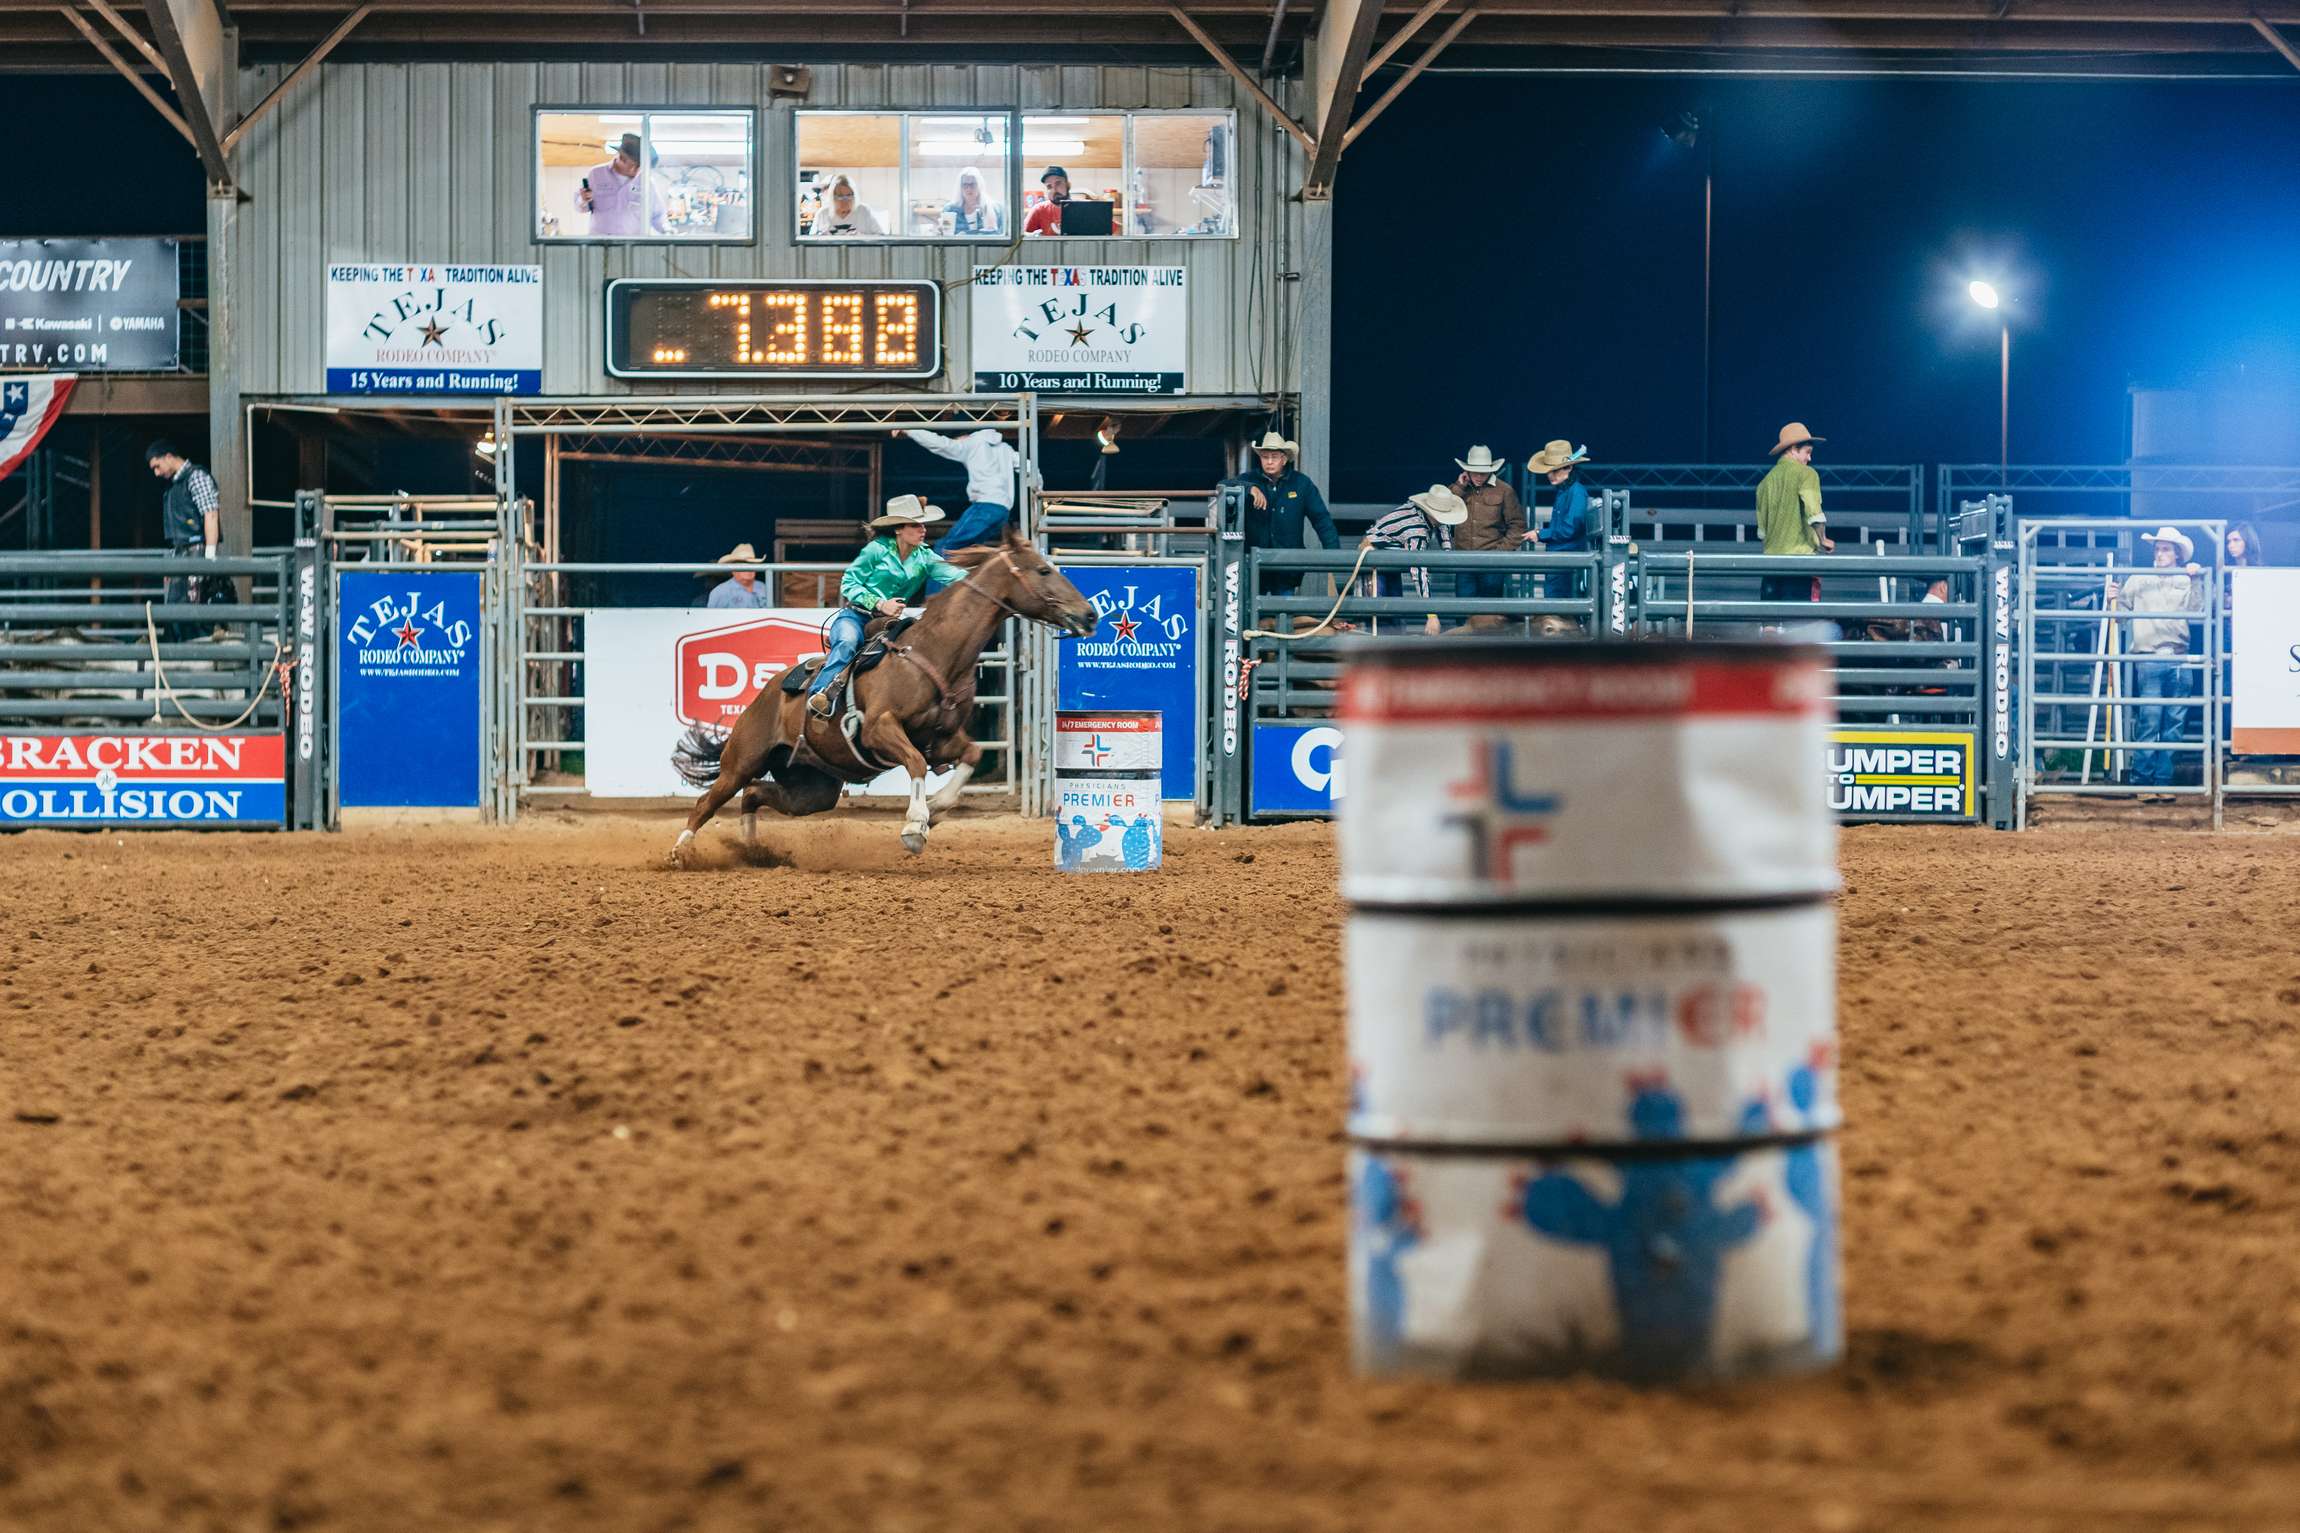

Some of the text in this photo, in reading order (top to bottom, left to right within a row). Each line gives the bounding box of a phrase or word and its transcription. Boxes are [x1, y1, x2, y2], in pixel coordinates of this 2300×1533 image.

[0, 259, 132, 291] COUNTRY
[331, 267, 378, 282] KEEPING
[382, 267, 404, 282] THE
[445, 268, 504, 284] TRADITION
[508, 268, 538, 284] ALIVE
[975, 268, 1022, 286] KEEPING
[1026, 268, 1047, 286] THE
[1090, 268, 1148, 287] TRADITION
[1153, 269, 1183, 287] ALIVE
[35, 317, 92, 331] Kawasaki
[123, 317, 165, 331] YAMAHA
[363, 288, 506, 346] TEJAS
[1013, 293, 1145, 344] TEJAS
[376, 350, 490, 364] RODEO COMPANY
[1028, 349, 1131, 364] RODEO COMPANY
[351, 372, 518, 394] 15 Years and Running!
[999, 373, 1162, 393] 10 Years and Running!
[347, 592, 472, 648] TEJAS
[1087, 586, 1188, 640] EJAS
[359, 649, 460, 665] RODEO COMPANY
[1077, 642, 1176, 656] RODEO COMPANY
[300, 644, 314, 760] RODEO
[1224, 640, 1237, 757] RODEO
[1995, 644, 2009, 760] RODEO
[720, 704, 747, 715] TEXA
[1075, 721, 1115, 729] EMERGENCY
[1116, 721, 1138, 729] ROOM
[0, 737, 245, 770] RACKEN
[1826, 749, 1961, 774] UMPER
[1069, 782, 1126, 790] PHYSICIANS
[1826, 773, 1855, 784] TO
[0, 790, 242, 818] OLLISION
[1063, 793, 1135, 807] PREMIER
[1826, 786, 1960, 811] UMPER
